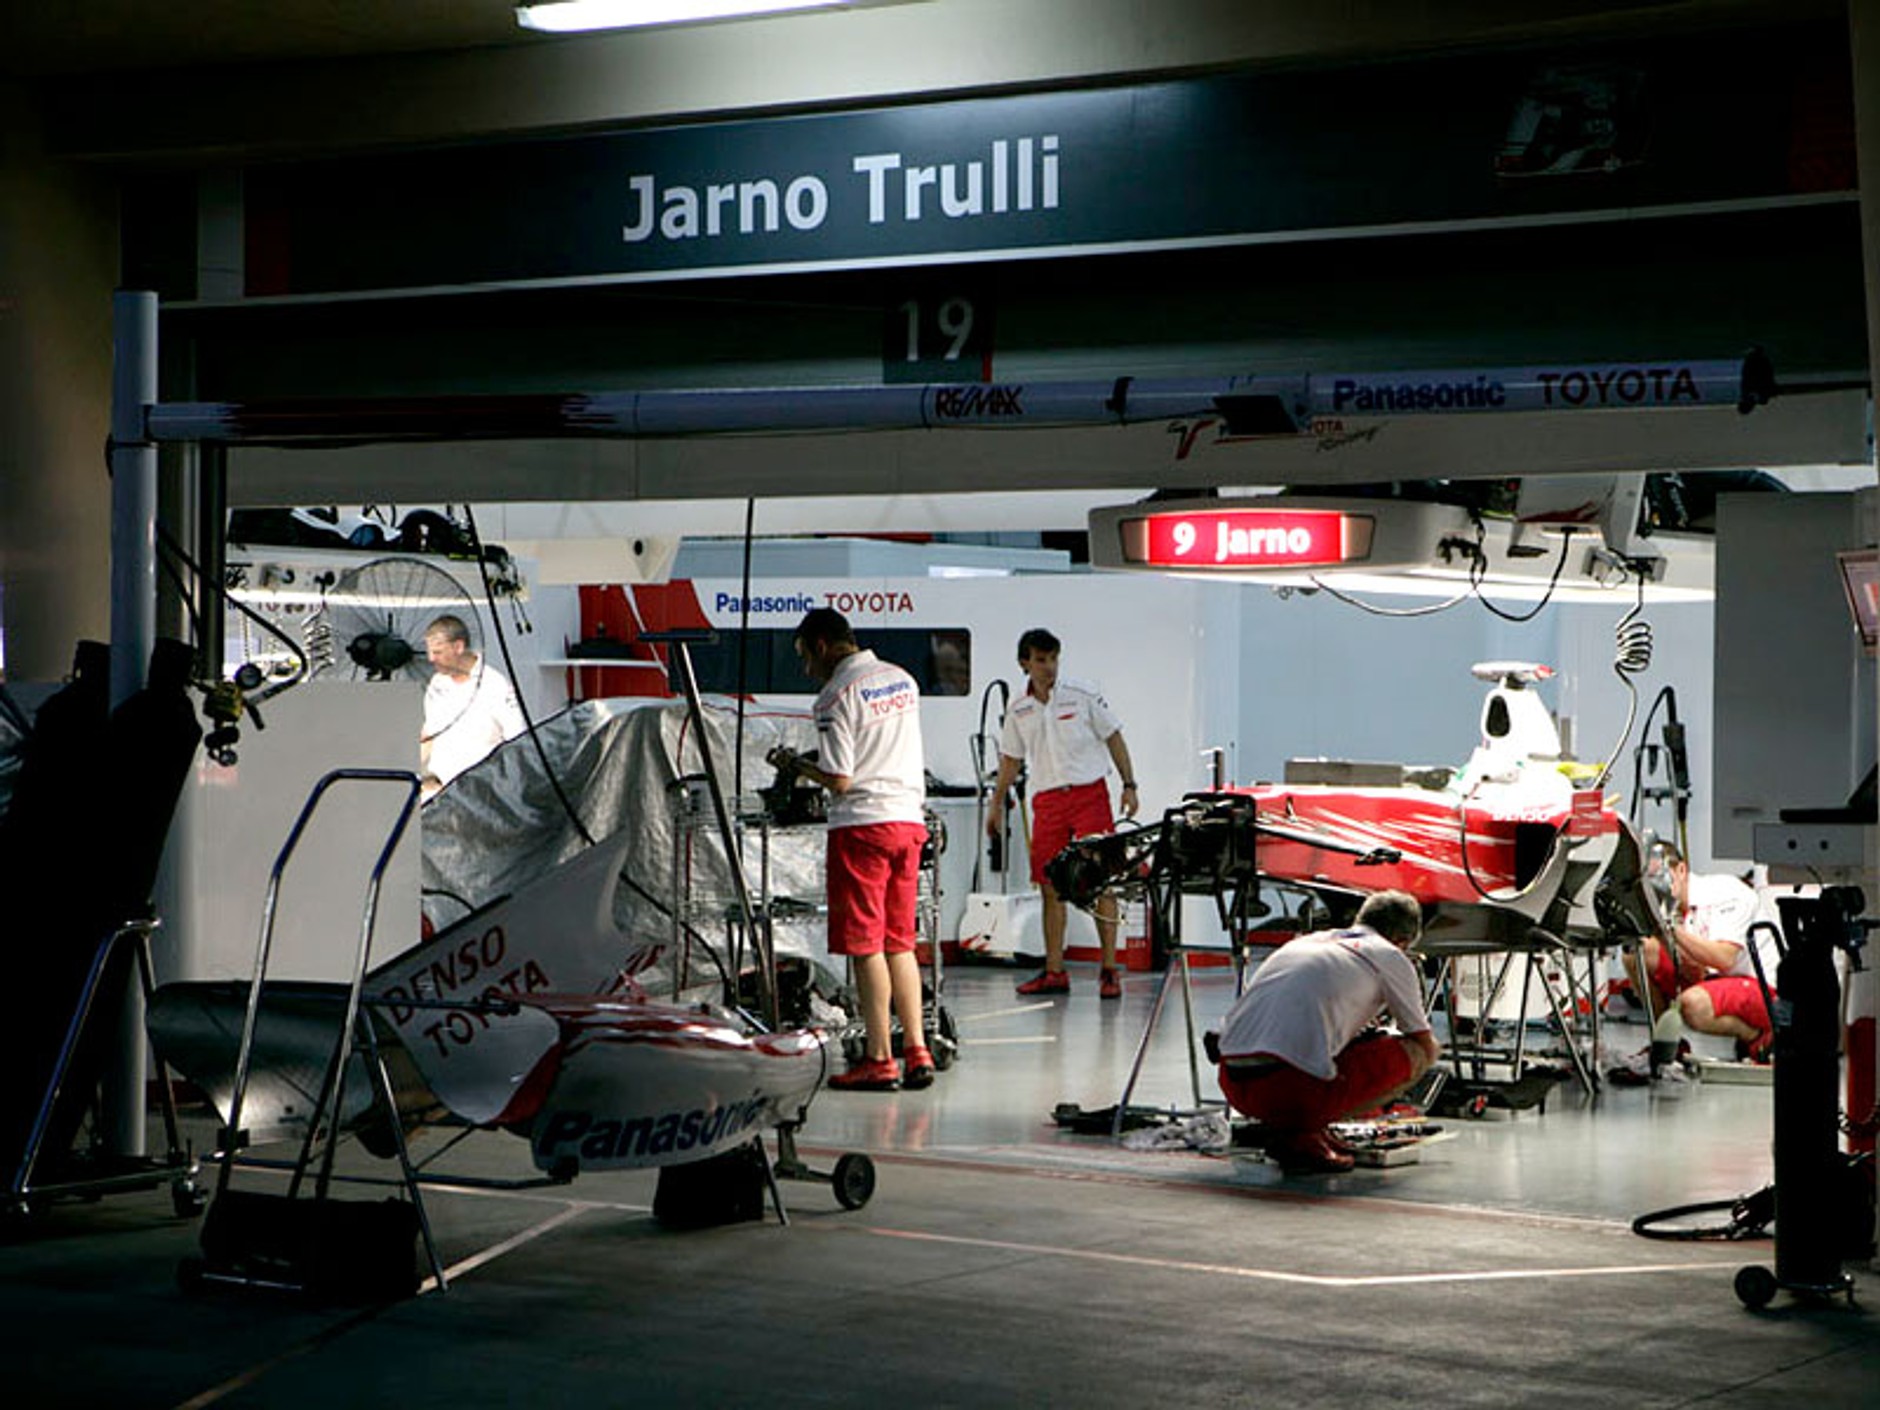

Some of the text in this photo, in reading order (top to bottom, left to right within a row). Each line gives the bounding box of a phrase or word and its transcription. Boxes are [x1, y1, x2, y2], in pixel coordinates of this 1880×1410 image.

[622, 134, 1060, 243] Jarno Trulli
[901, 297, 974, 362] 19
[1333, 368, 1701, 411] Panasonic TOYOTA
[1172, 521, 1311, 562] 9 Jarno
[824, 592, 914, 613] TOYOTA
[382, 925, 505, 1026] DENSO
[537, 1088, 769, 1159] Panasonic
